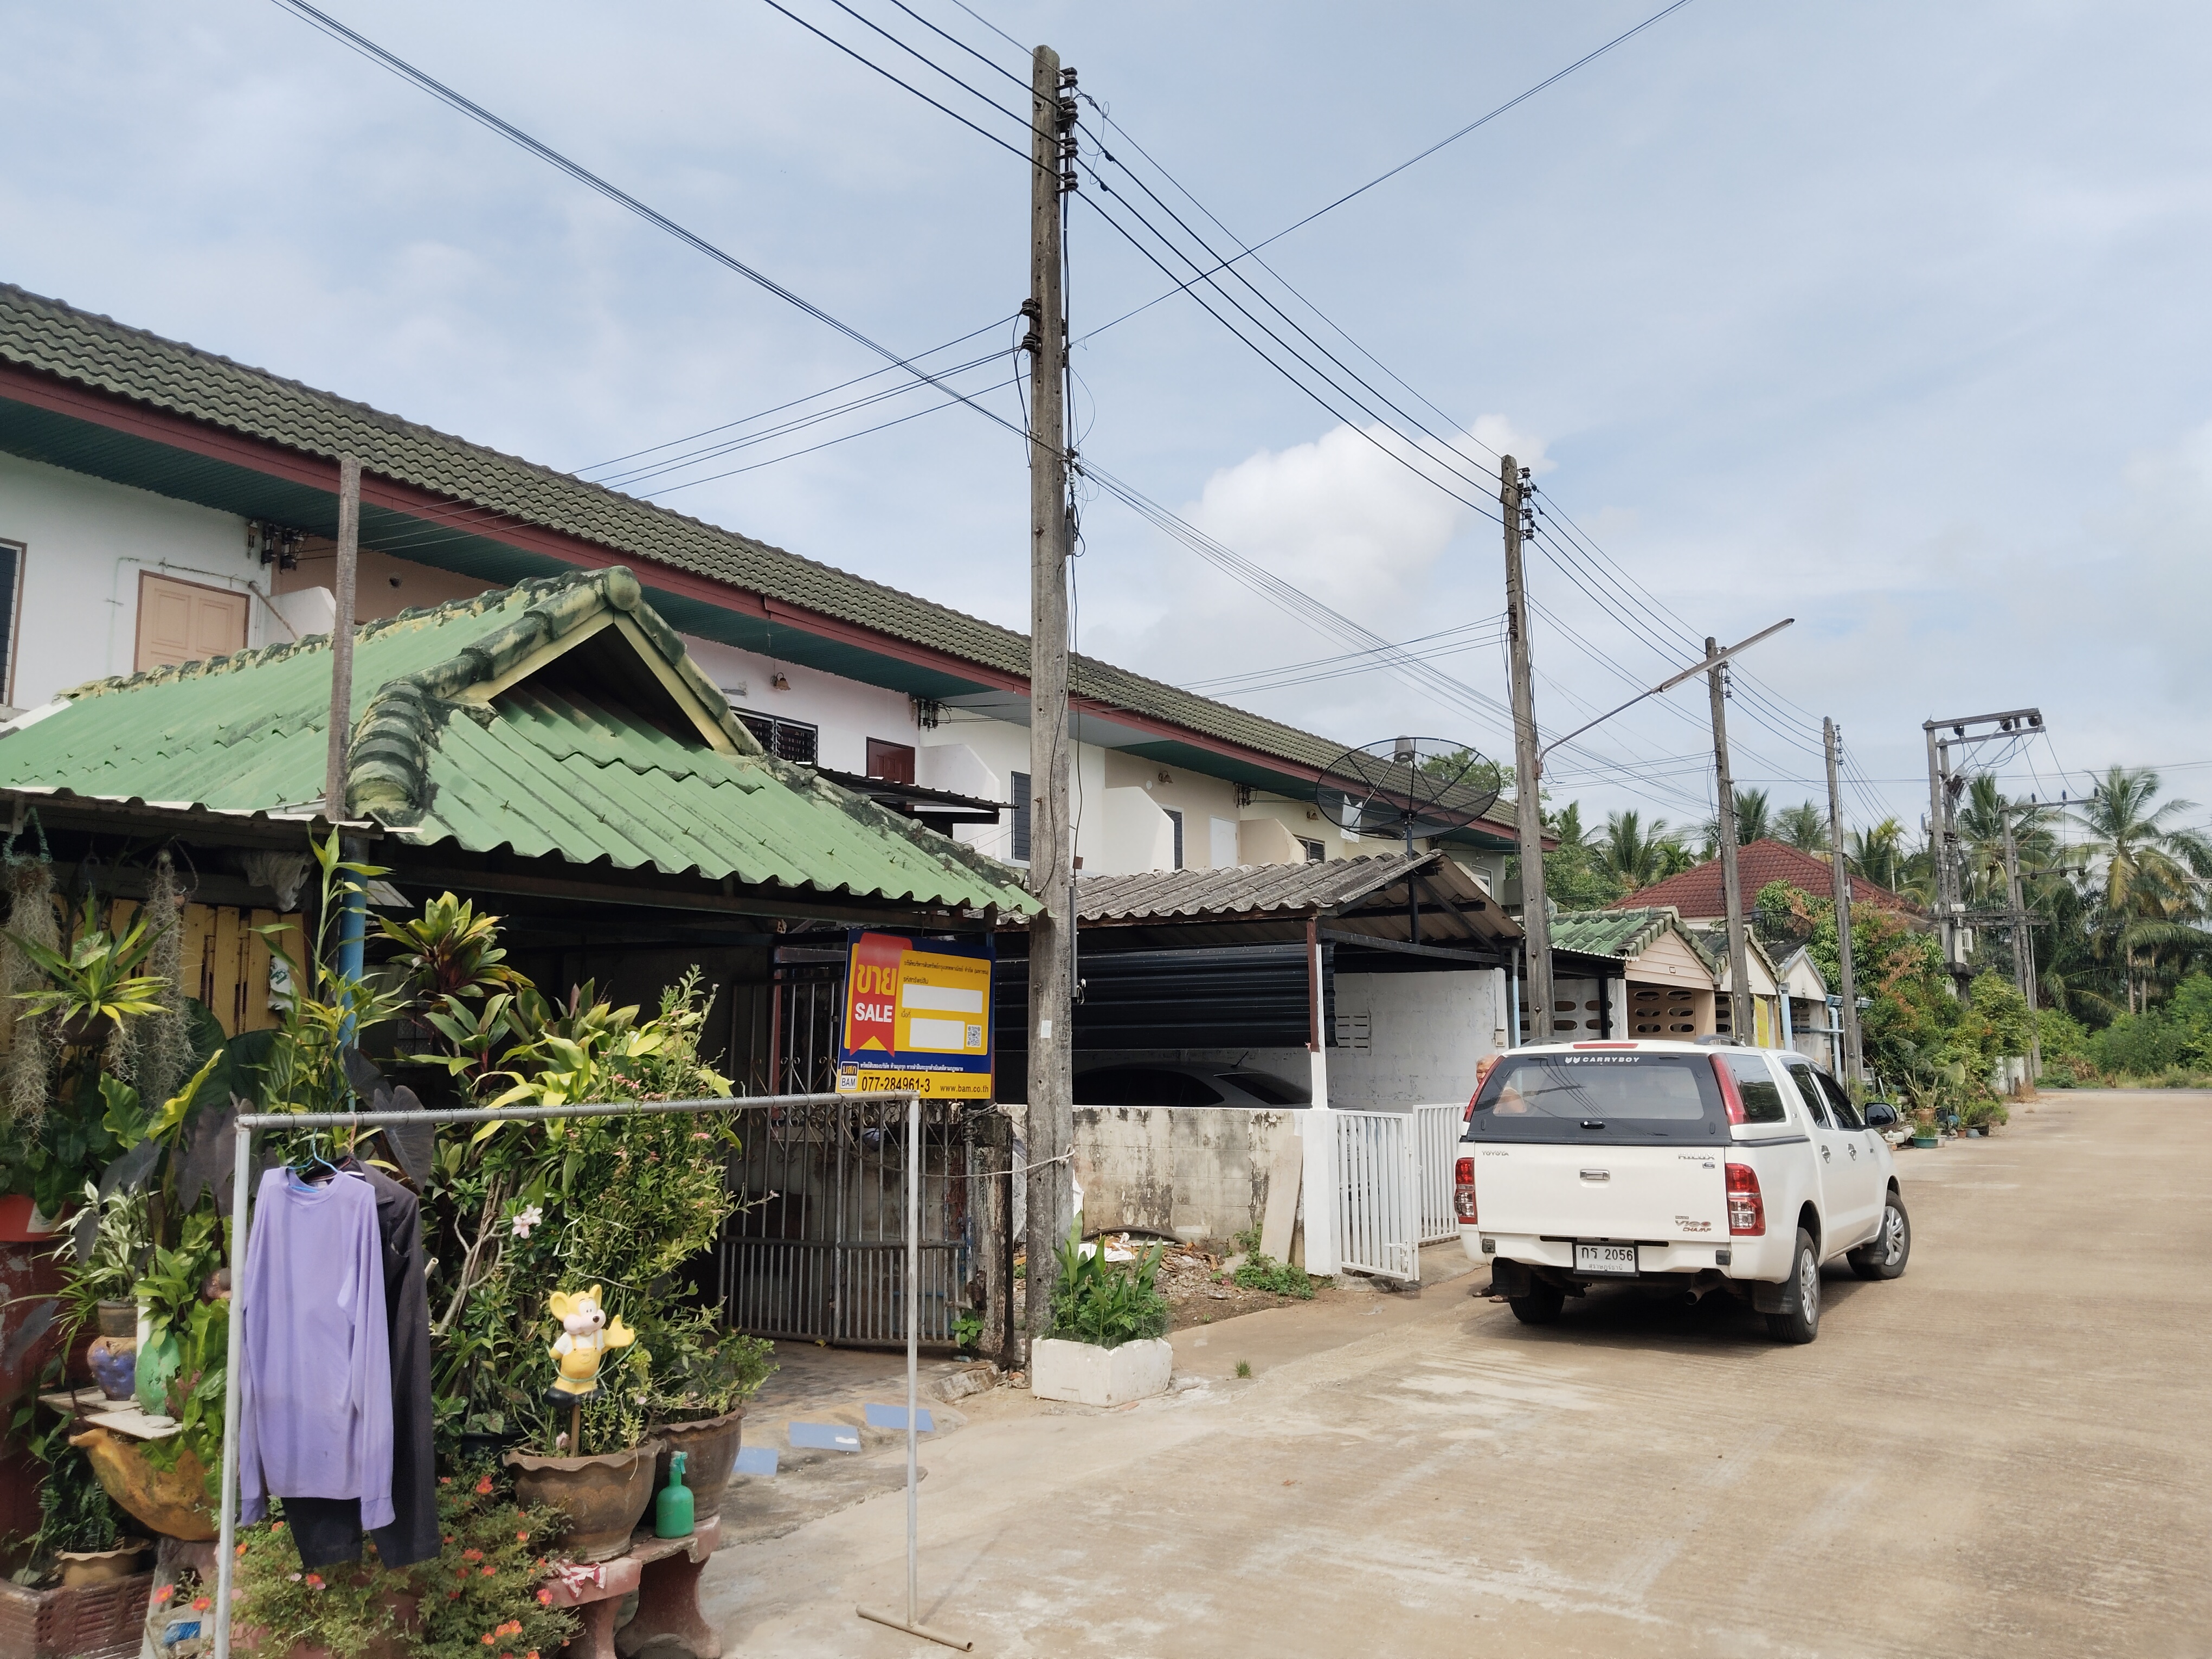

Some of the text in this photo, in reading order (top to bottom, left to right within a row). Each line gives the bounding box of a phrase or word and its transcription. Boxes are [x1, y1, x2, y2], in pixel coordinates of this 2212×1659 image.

[857, 964, 897, 996] ขาย
[855, 1002, 893, 1023] SALE
[843, 1065, 857, 1075] บสก
[841, 1077, 856, 1087] BAM
[861, 1076, 930, 1092] 077-284961-3
[940, 1084, 989, 1092] www.bam.co.th
[1581, 1247, 1633, 1261] กร 2056
